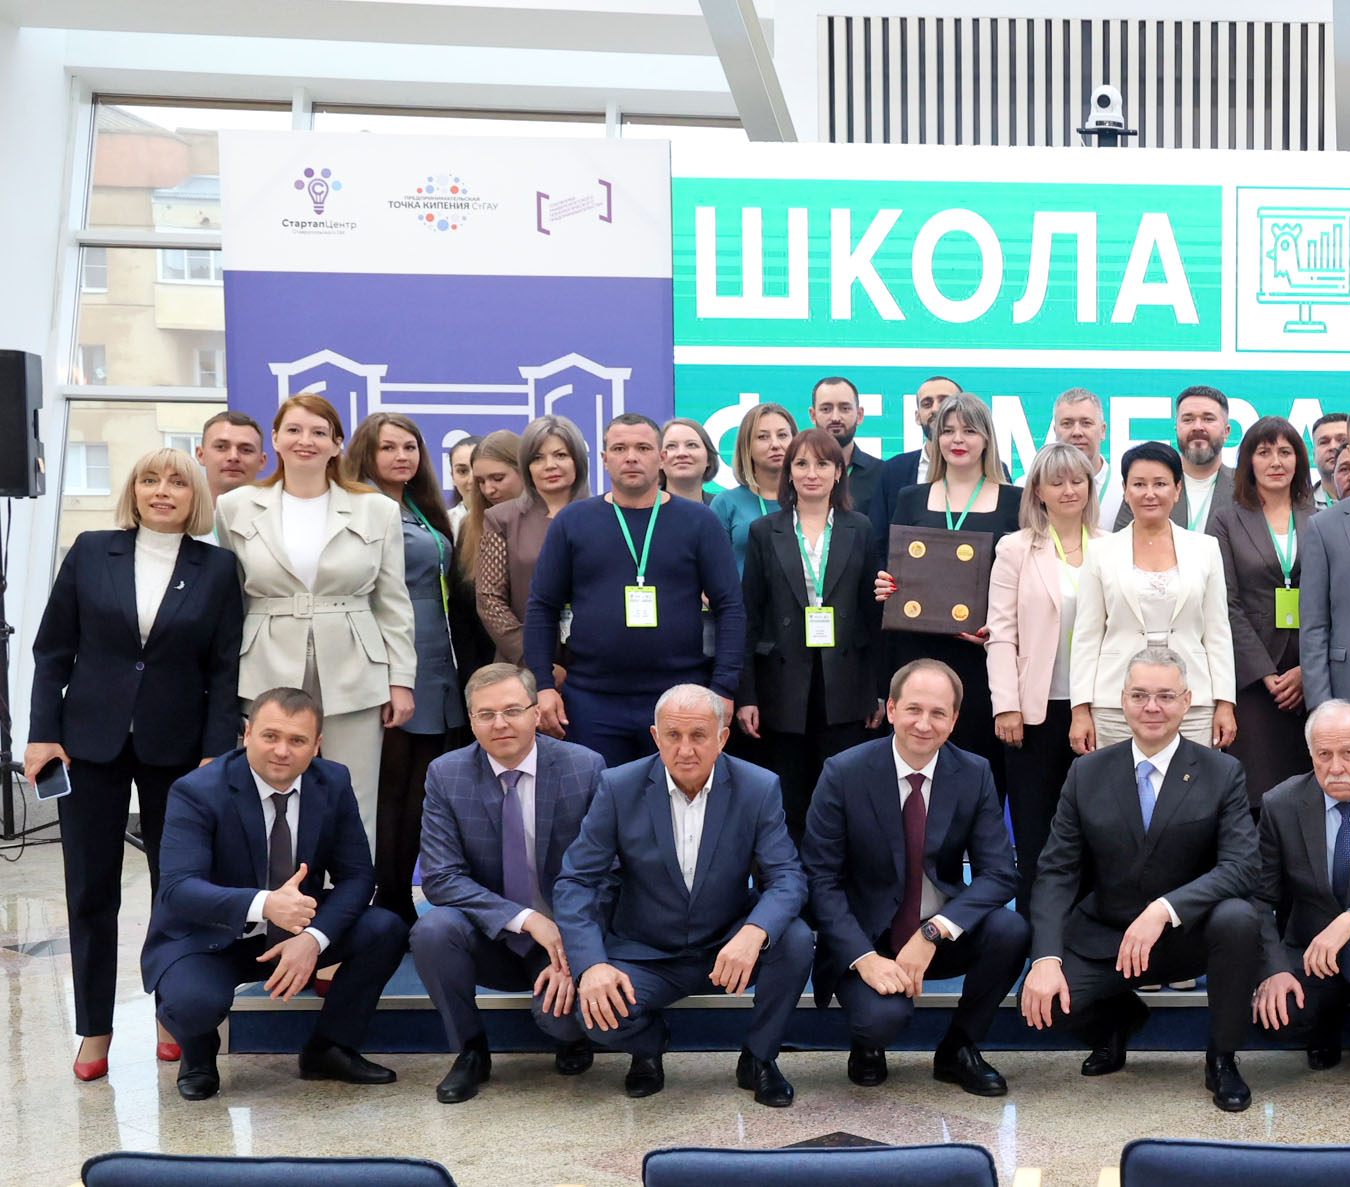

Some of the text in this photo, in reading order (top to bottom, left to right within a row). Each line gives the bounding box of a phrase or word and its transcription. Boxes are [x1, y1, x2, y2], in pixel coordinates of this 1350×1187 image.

[388, 200, 421, 209] ТОЧКА
[423, 201, 470, 209] КИПЕНИЯ
[282, 218, 357, 230] СтартапЦентр
[695, 206, 1200, 324] ШКОЛА
